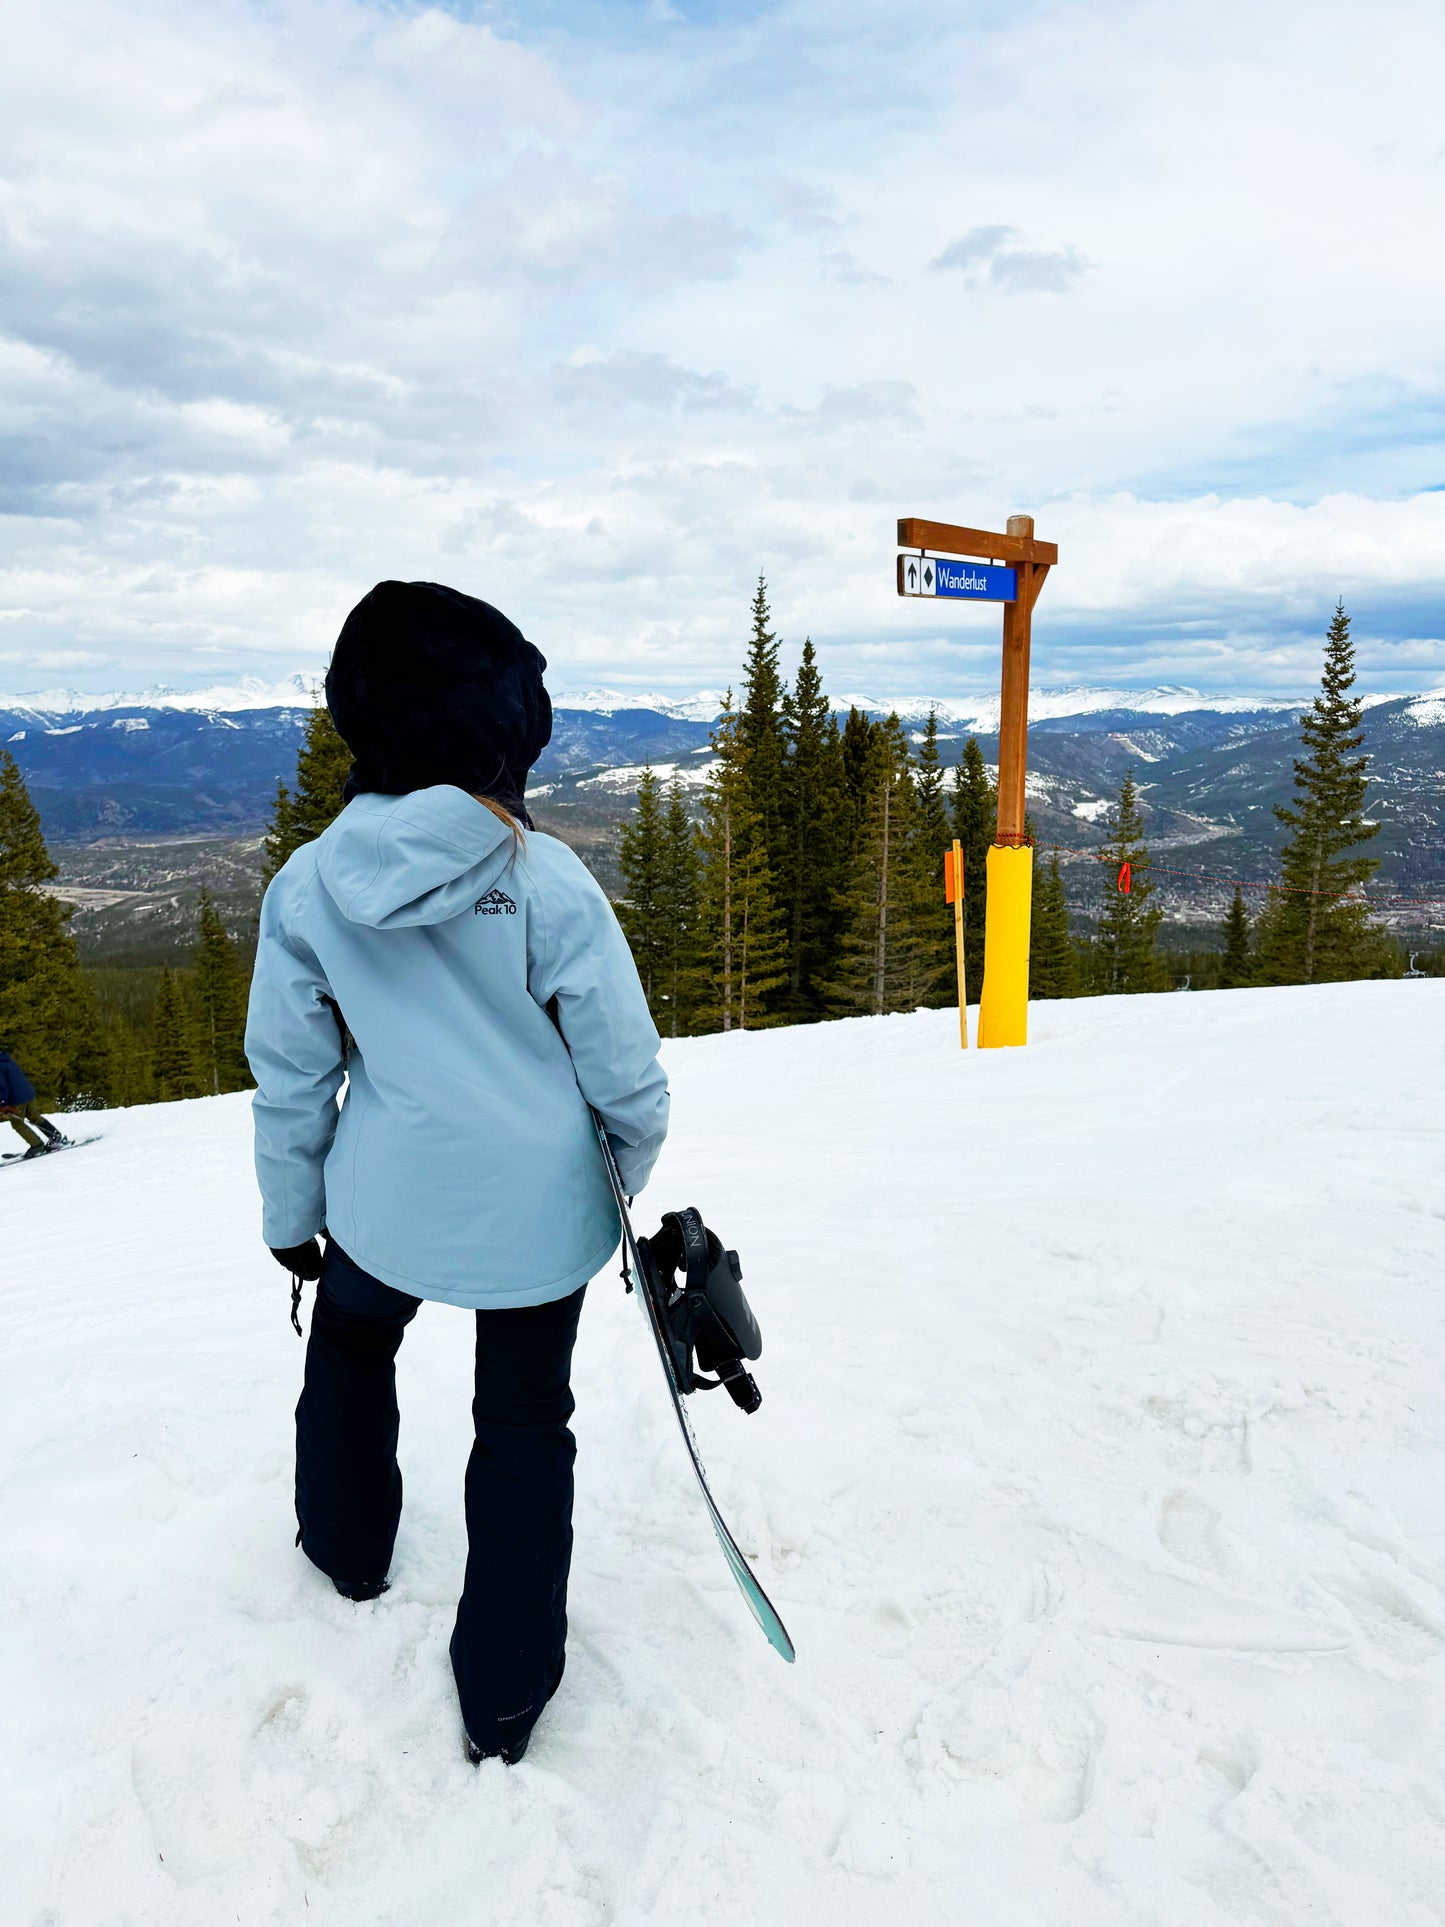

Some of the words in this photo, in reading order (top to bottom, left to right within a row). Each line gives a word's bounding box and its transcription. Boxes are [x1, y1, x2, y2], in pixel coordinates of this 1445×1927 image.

[937, 567, 987, 591] Wanderlust
[474, 904, 502, 915] Peak
[504, 904, 517, 915] 10
[681, 1211, 702, 1247] UNION
